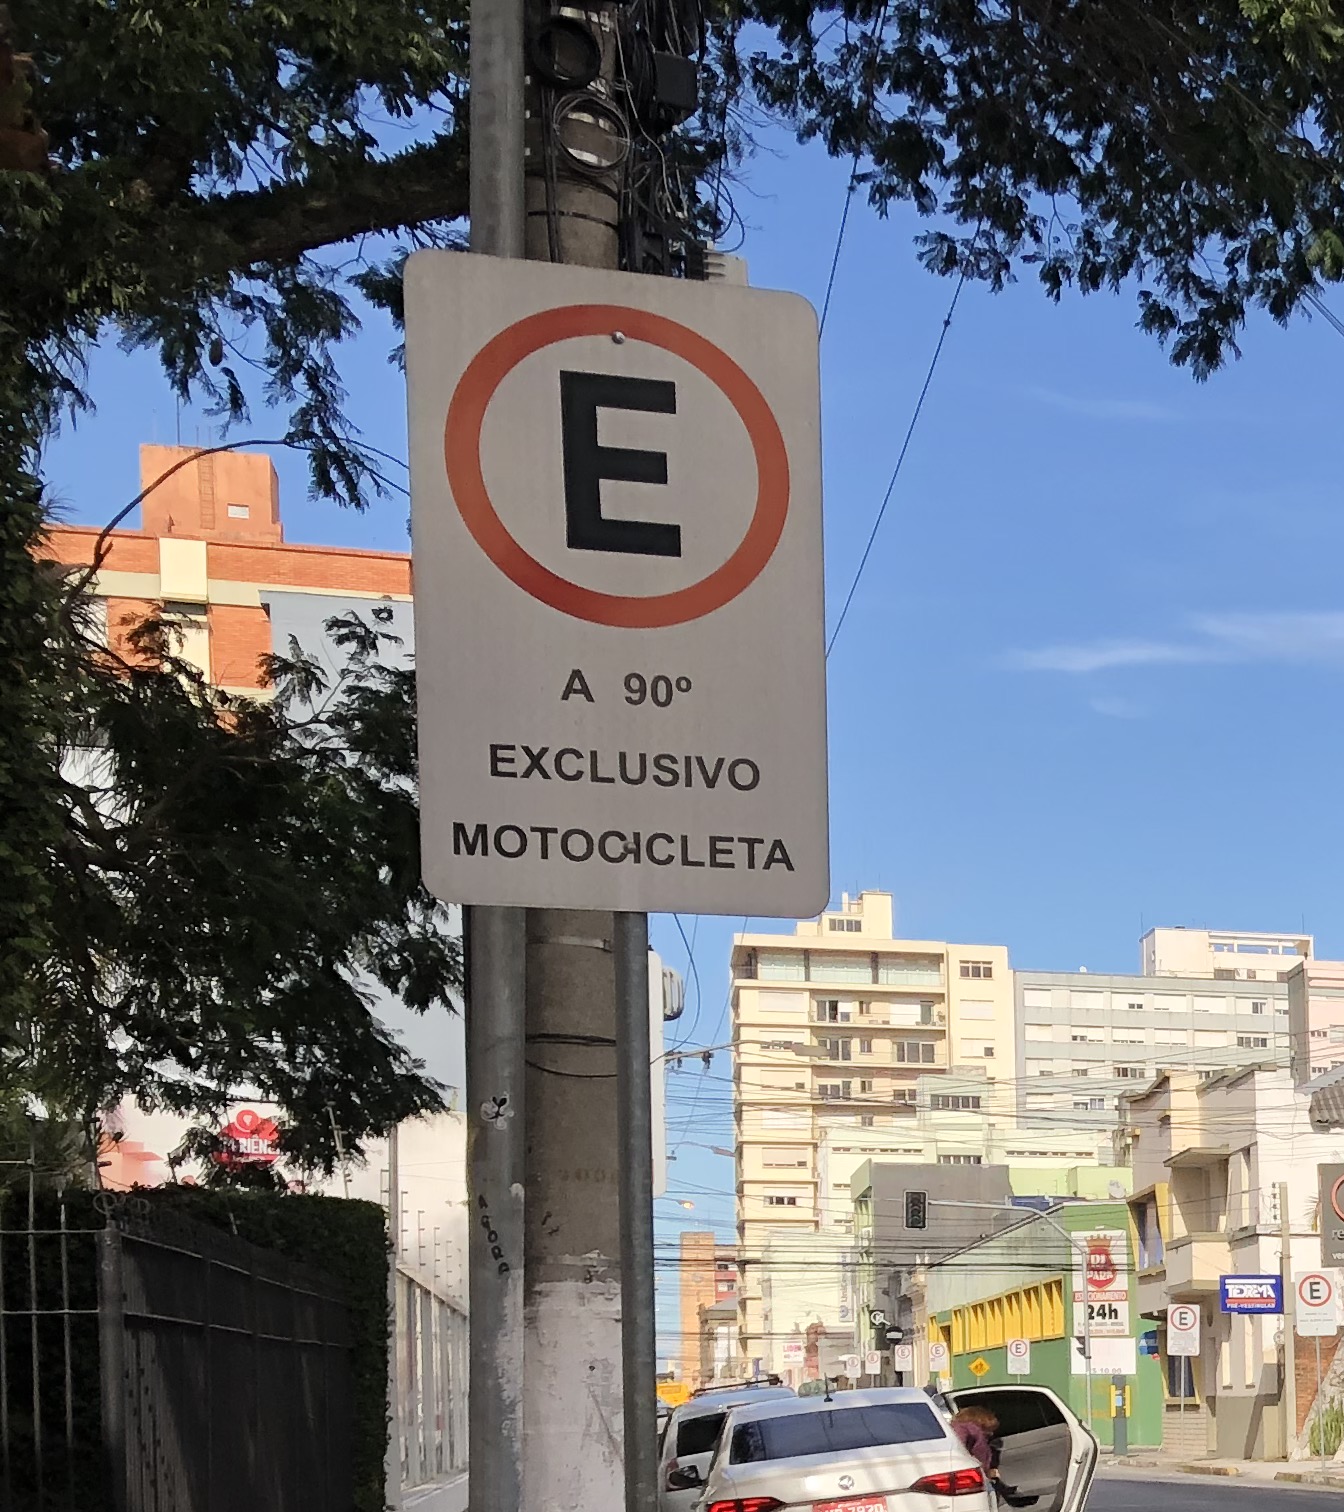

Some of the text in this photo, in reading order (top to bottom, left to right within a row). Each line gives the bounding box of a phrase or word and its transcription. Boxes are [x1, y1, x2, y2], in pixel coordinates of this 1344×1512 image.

[560, 370, 682, 558] E
[561, 669, 595, 703] A
[489, 743, 761, 792] EXCLUSIVO
[452, 821, 796, 872] MOTOCICLETA
[1308, 1281, 1322, 1300] E
[1087, 1303, 1119, 1320] 24h
[1178, 1311, 1189, 1326] E
